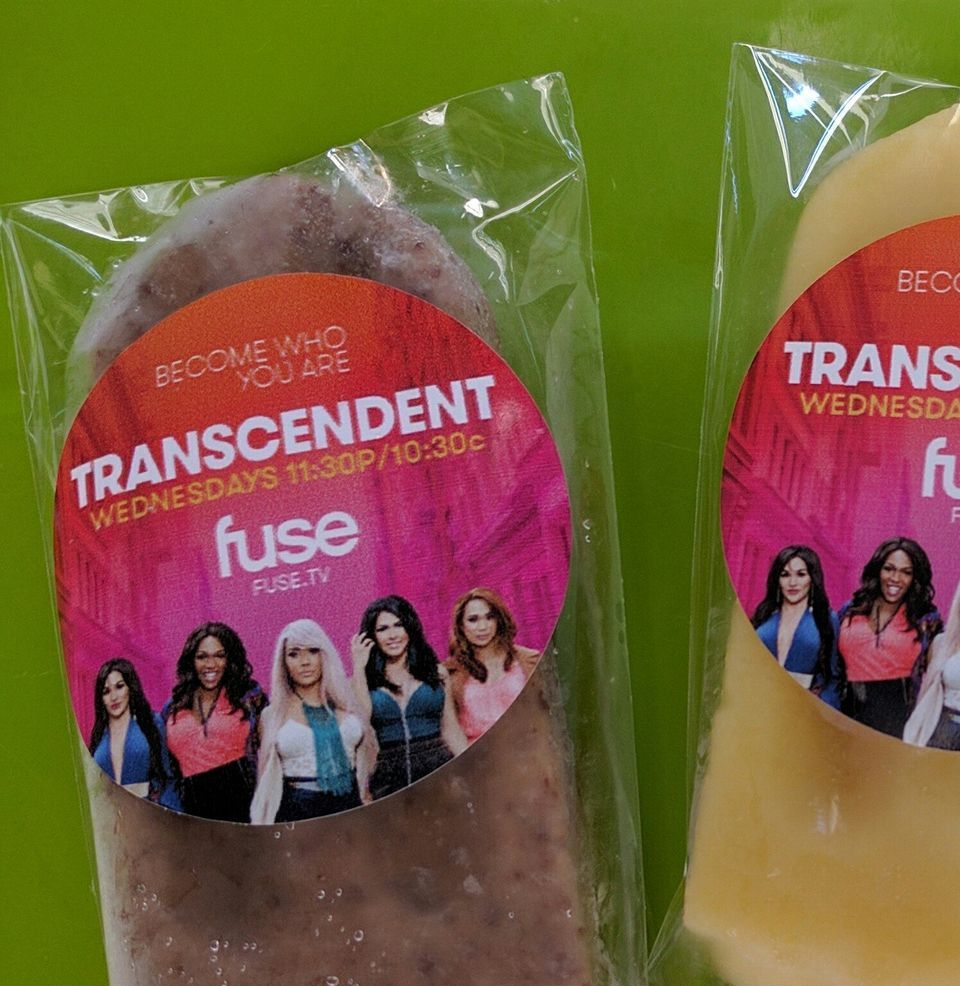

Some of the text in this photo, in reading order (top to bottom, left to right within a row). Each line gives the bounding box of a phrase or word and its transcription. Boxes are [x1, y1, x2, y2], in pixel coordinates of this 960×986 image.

[156, 325, 347, 388] BECOME WHO
[235, 349, 350, 392] YOU ARE
[71, 375, 495, 510] TRANSCENDENT
[90, 465, 278, 531] WEDNESDAYS
[216, 511, 359, 578] fuse
[252, 568, 332, 597] FUSE.TV
